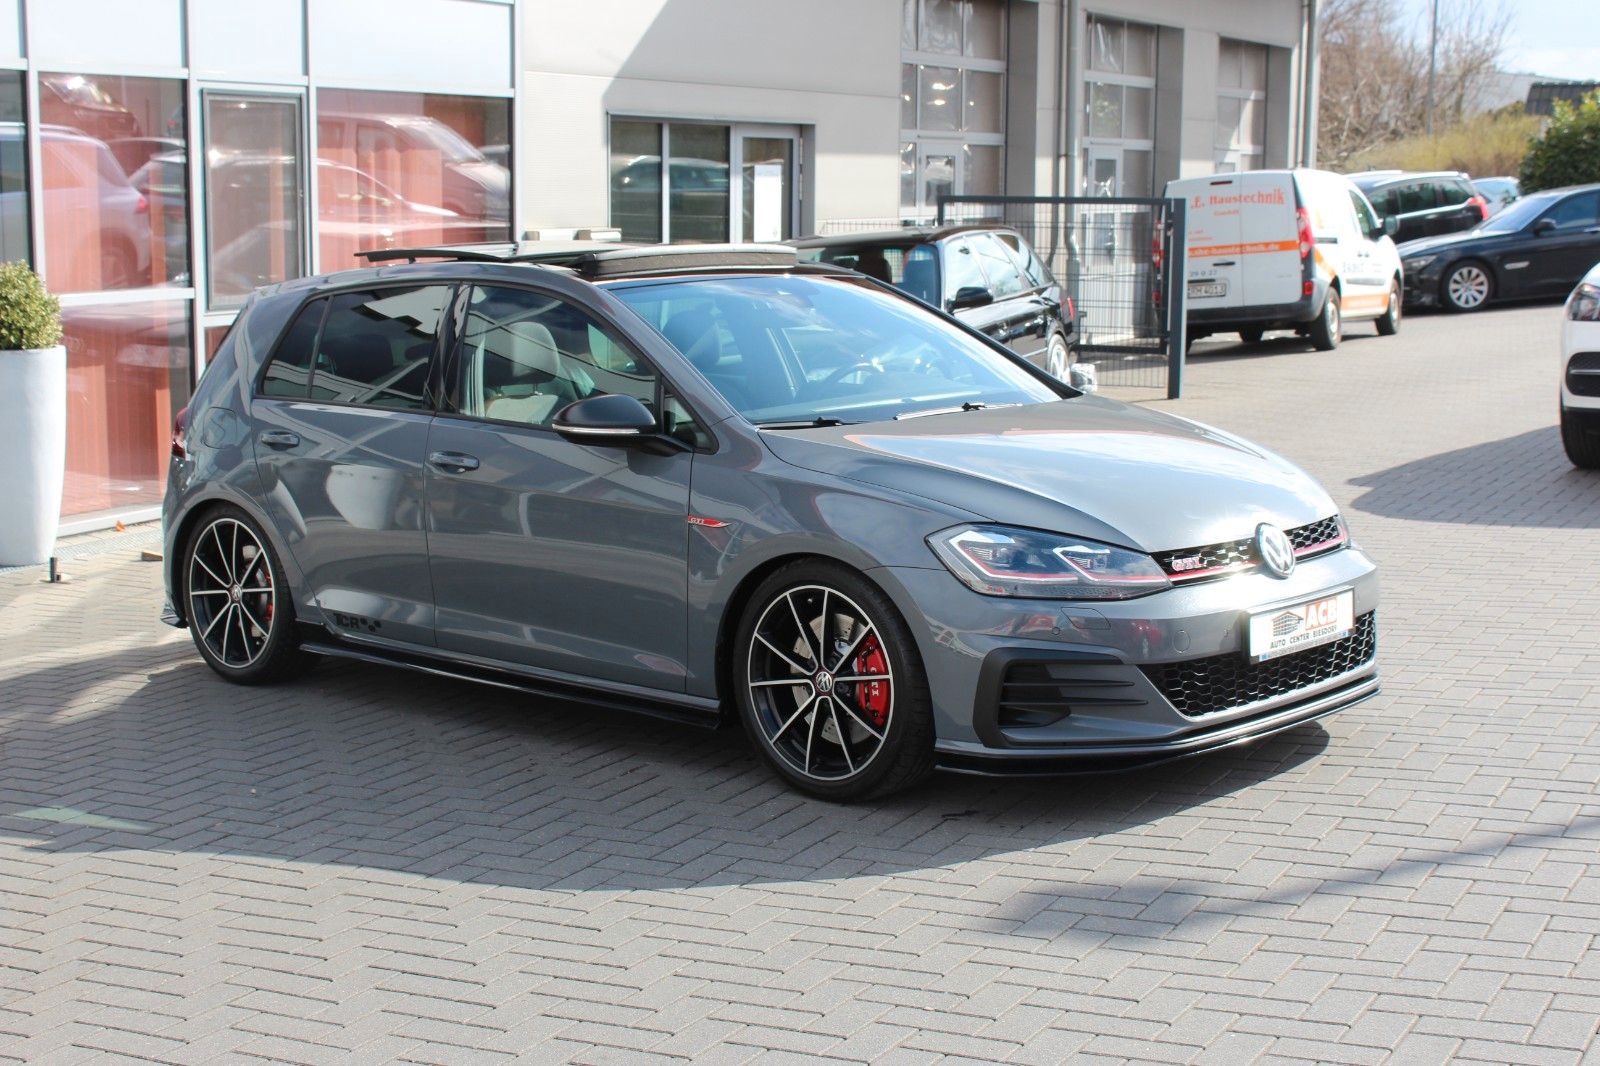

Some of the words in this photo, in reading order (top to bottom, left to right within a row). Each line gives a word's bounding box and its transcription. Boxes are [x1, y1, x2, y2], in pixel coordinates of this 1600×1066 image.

[1209, 188, 1285, 206] Haustechnik
[690, 517, 705, 525] GTI
[1172, 556, 1200, 572] GTI
[1270, 639, 1286, 649] AUTO
[1289, 633, 1310, 644] CENTER
